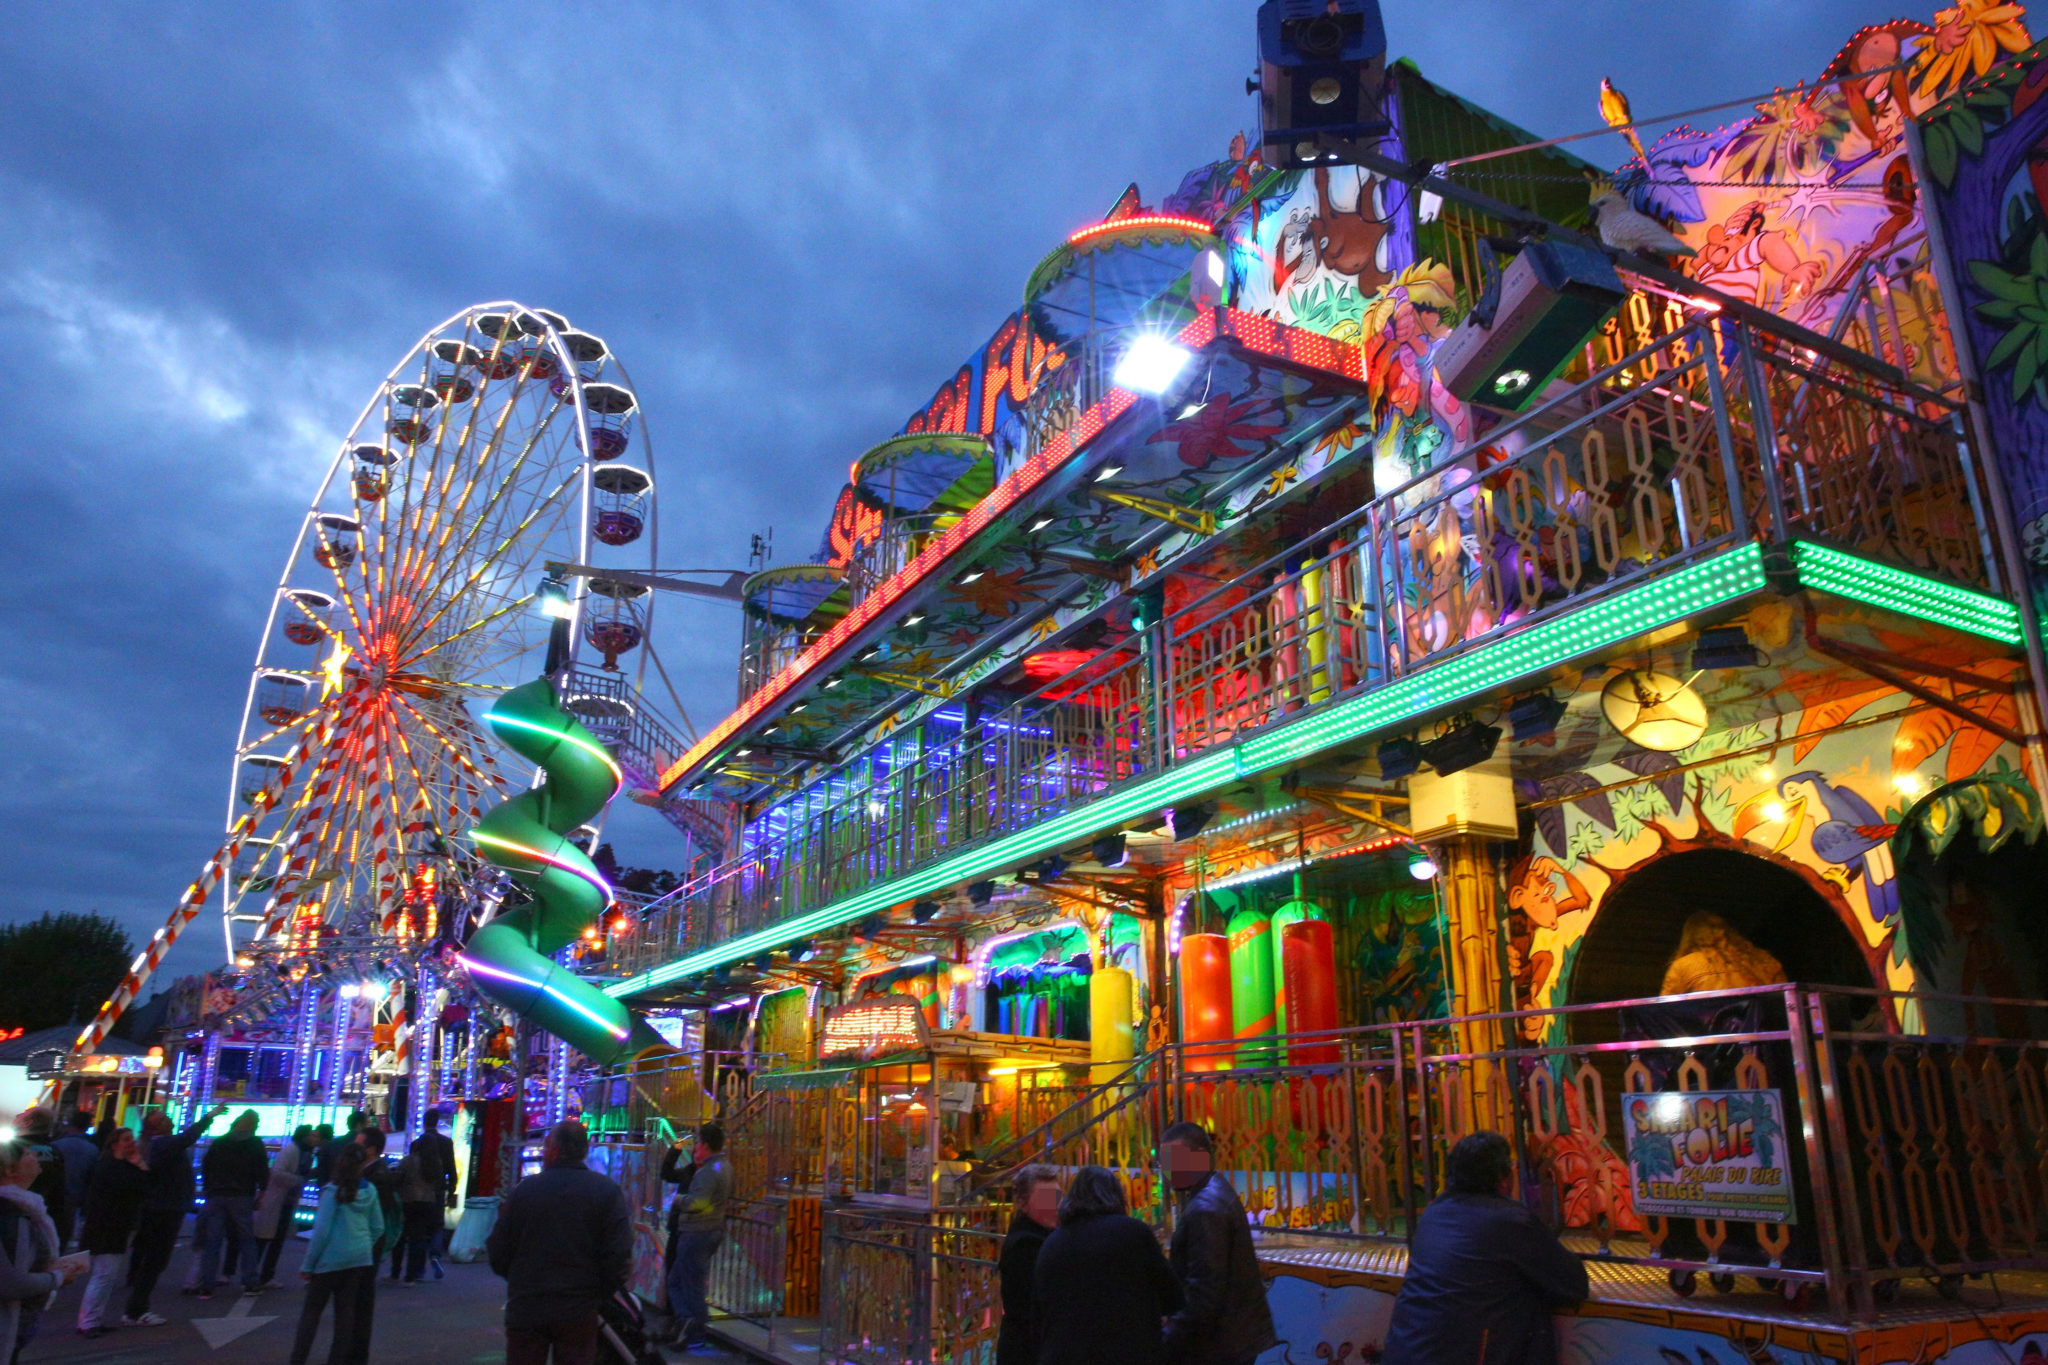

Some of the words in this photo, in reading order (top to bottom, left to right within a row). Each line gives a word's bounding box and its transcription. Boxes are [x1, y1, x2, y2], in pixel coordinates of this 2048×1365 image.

[1630, 1096, 1728, 1135] SAARI
[1671, 1117, 1754, 1169] FOLIE
[1680, 1165, 1725, 1184] PALAIS
[1726, 1166, 1747, 1184] DU
[1750, 1166, 1782, 1186] RIRE
[1637, 1181, 1648, 1199] 3
[1651, 1181, 1704, 1201] ETAGES
